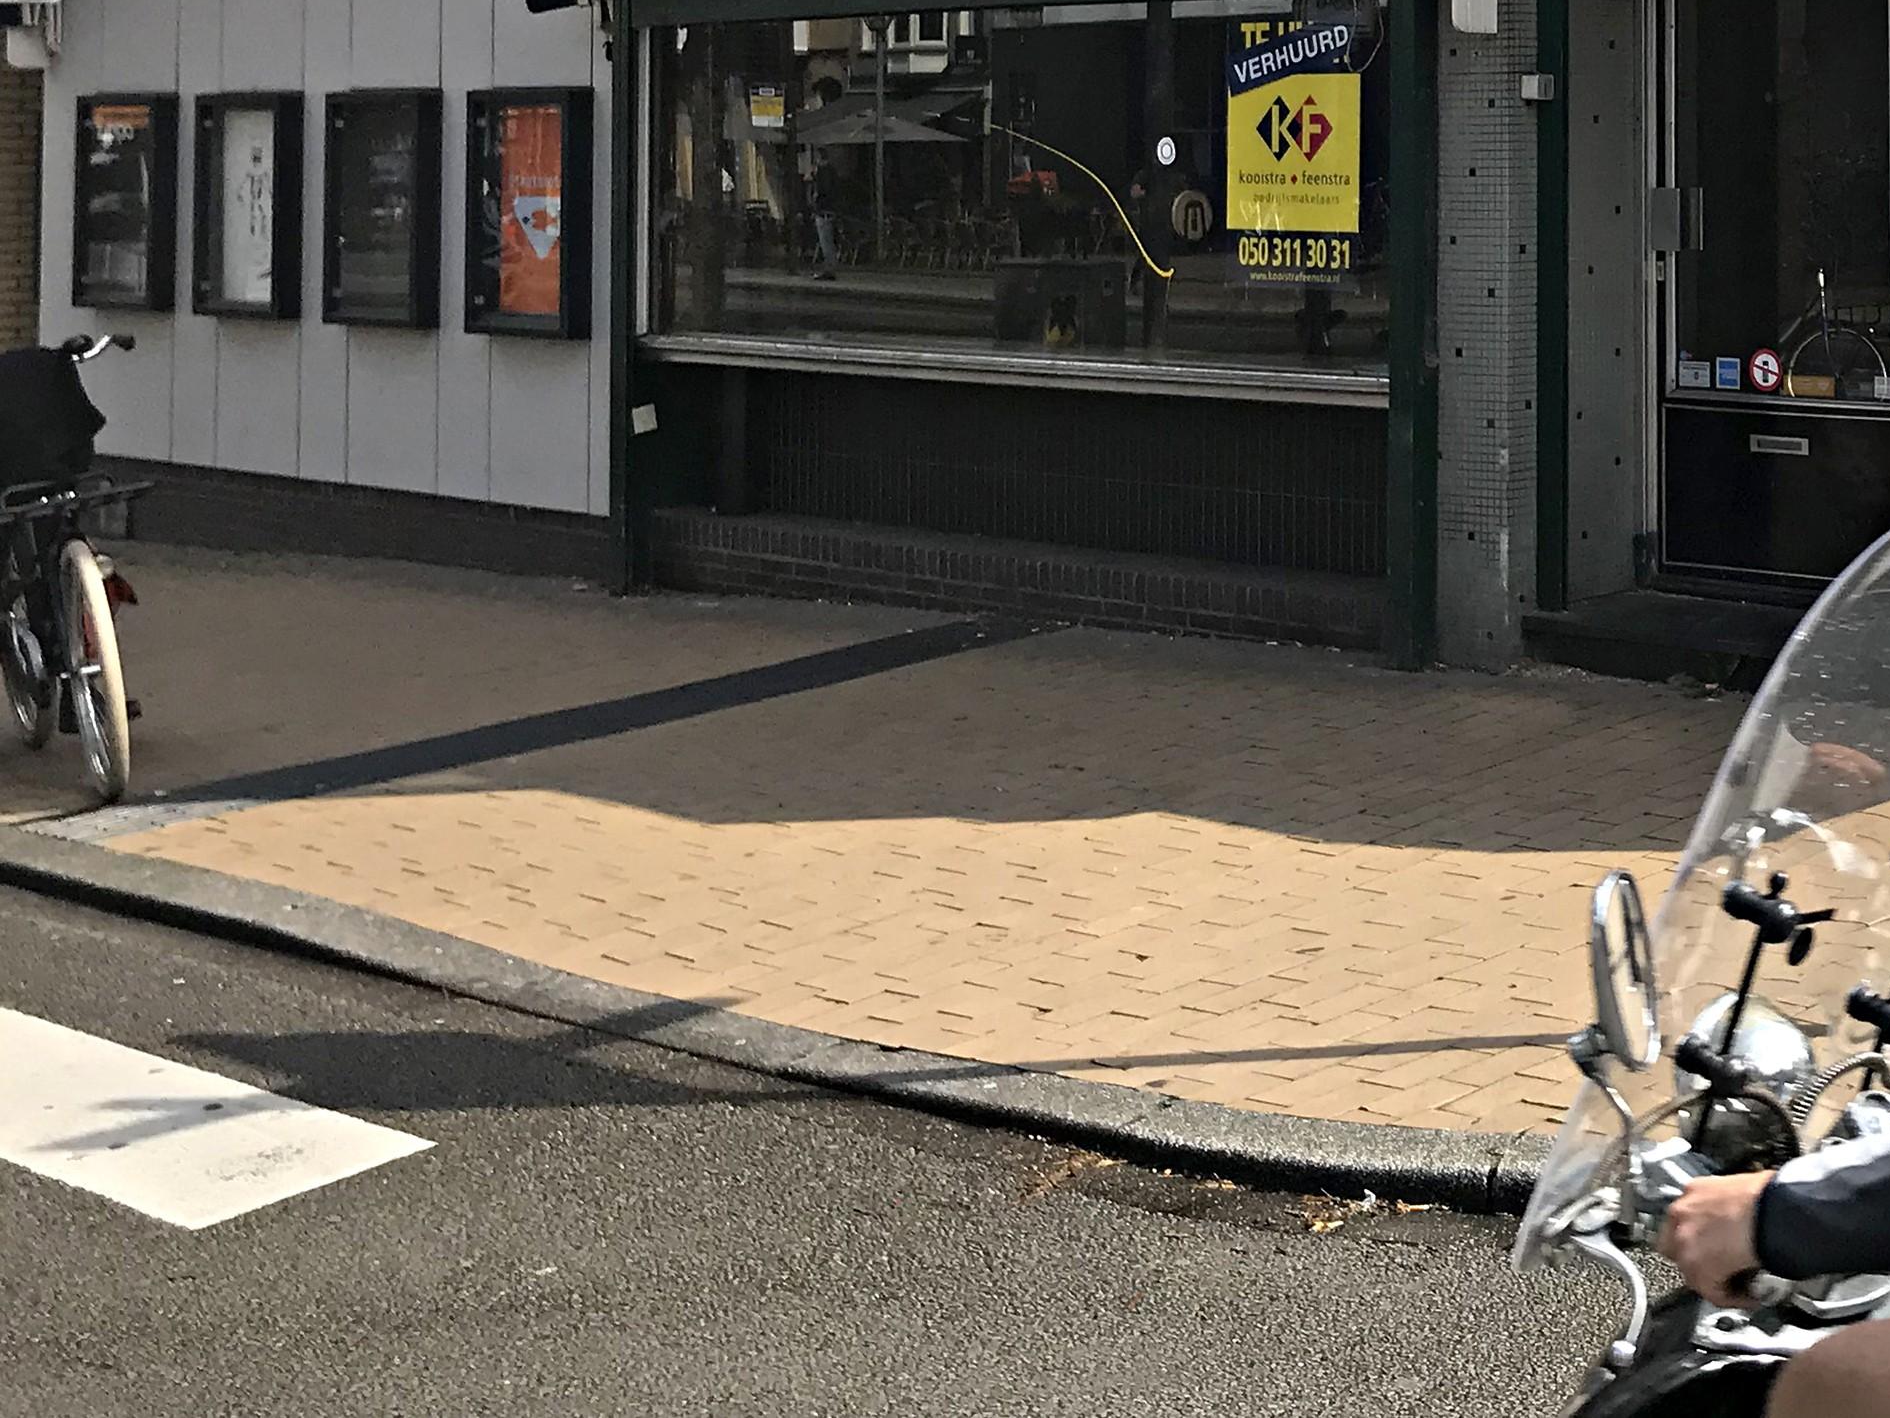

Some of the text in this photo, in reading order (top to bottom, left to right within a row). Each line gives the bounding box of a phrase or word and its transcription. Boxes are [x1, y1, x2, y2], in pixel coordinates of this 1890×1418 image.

[1233, 25, 1349, 83] VERHUURD
[1239, 170, 1351, 186] kooistra feenstra
[1239, 237, 1350, 269] 050 311 30 31
